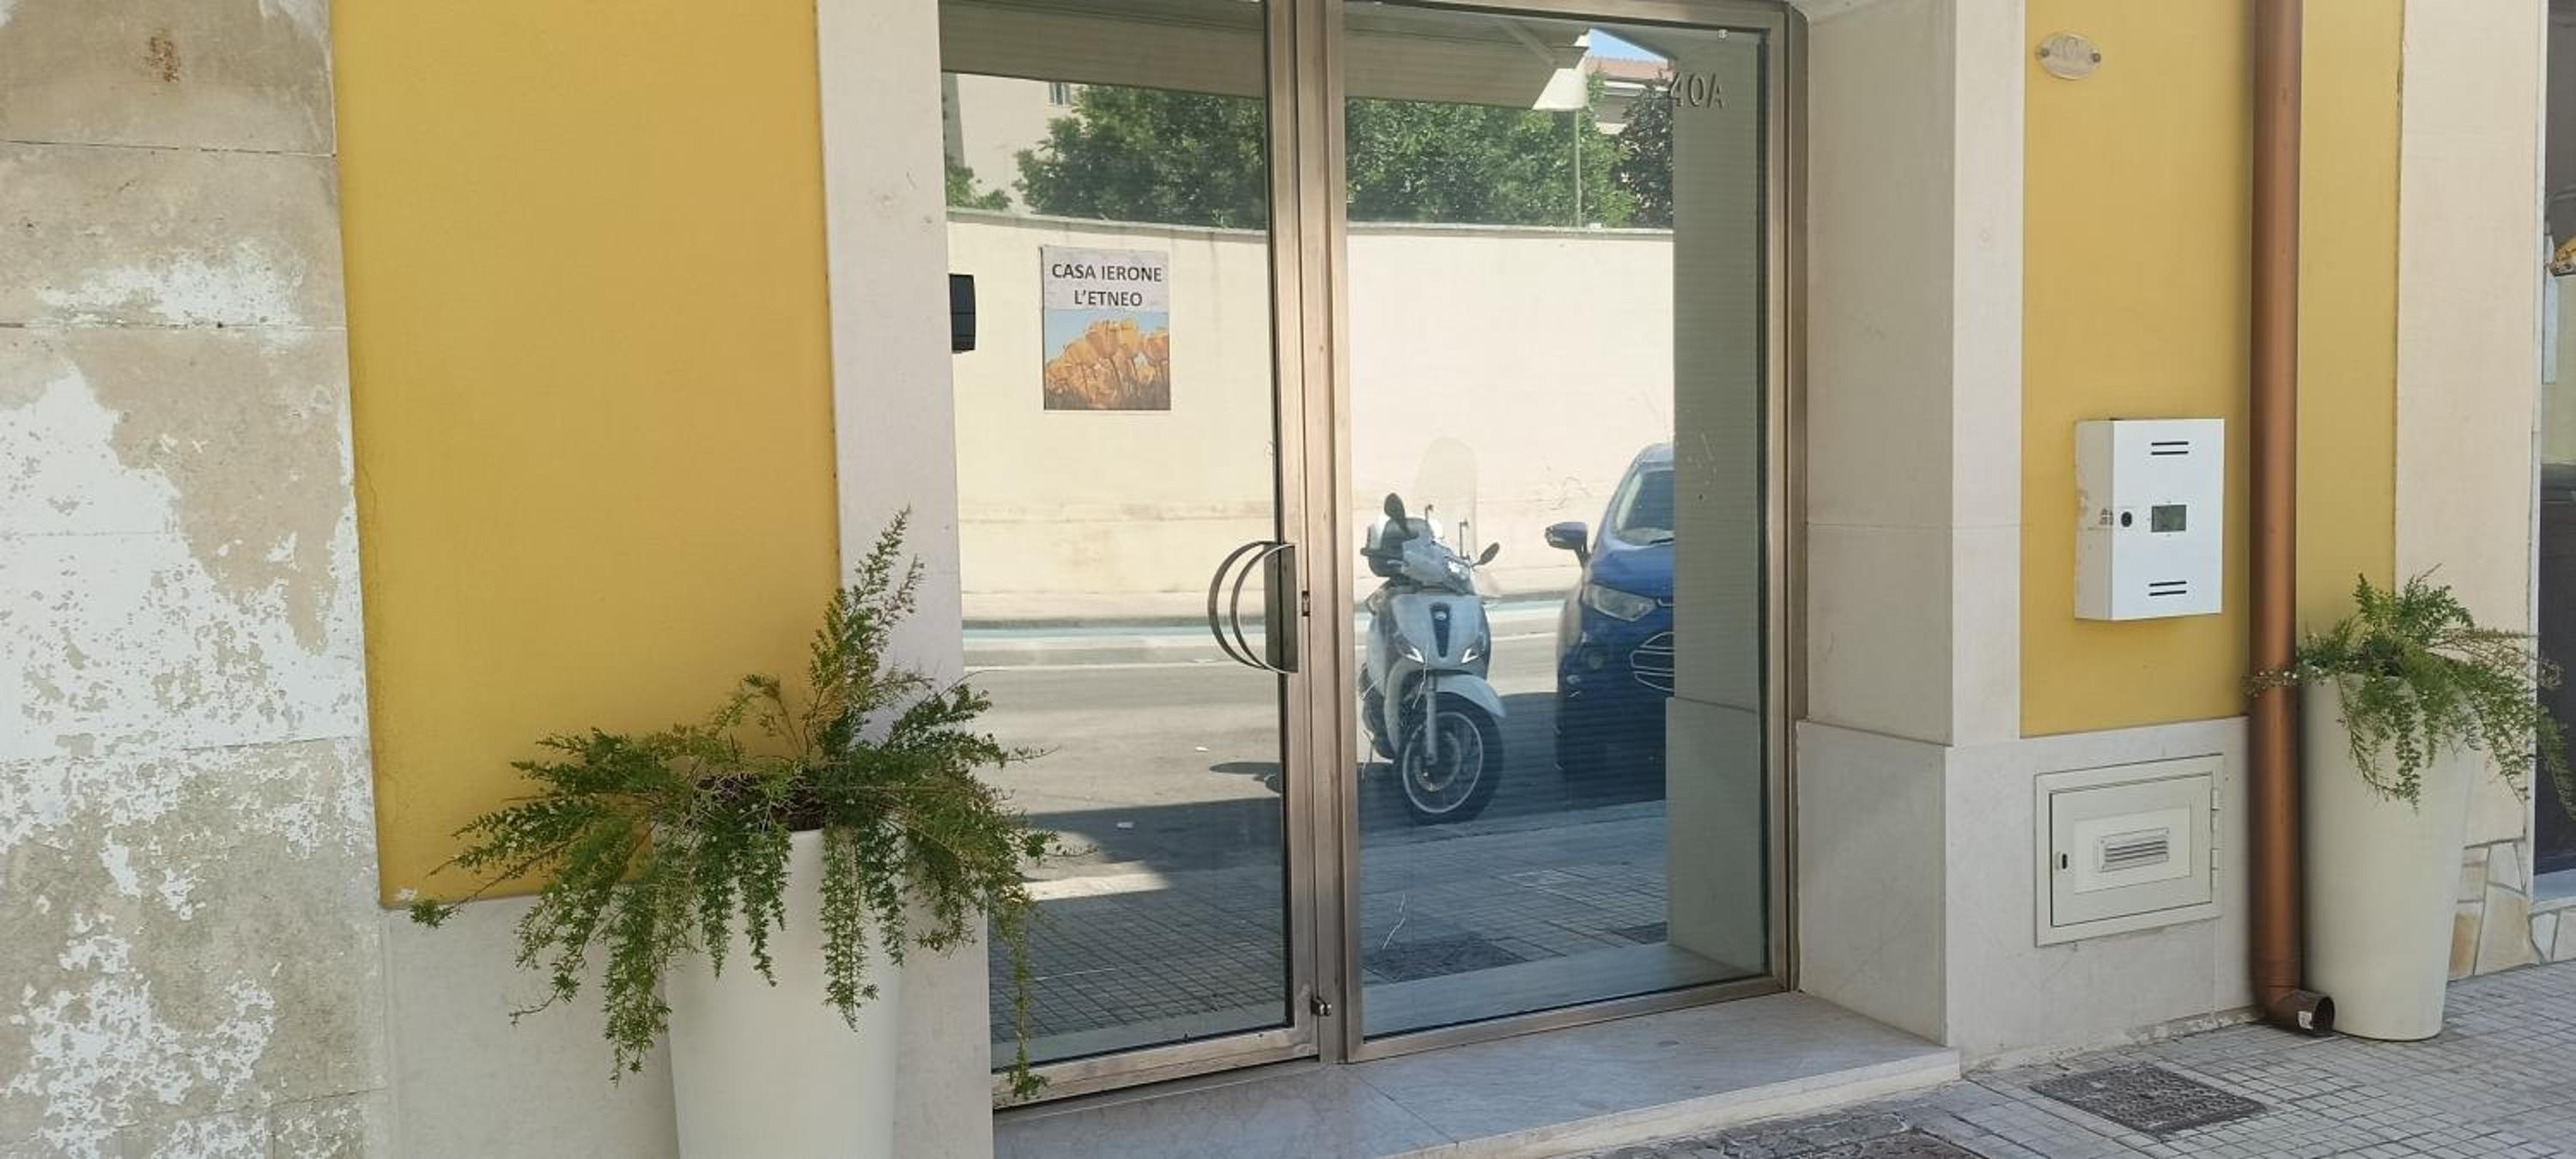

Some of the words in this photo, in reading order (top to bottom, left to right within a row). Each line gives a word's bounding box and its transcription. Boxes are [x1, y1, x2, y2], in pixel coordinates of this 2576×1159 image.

[1668, 70, 1724, 109] 40A
[1052, 264, 1097, 280] CASA
[1101, 265, 1162, 282] IERONE
[1073, 289, 1143, 306] L’ETNEO
